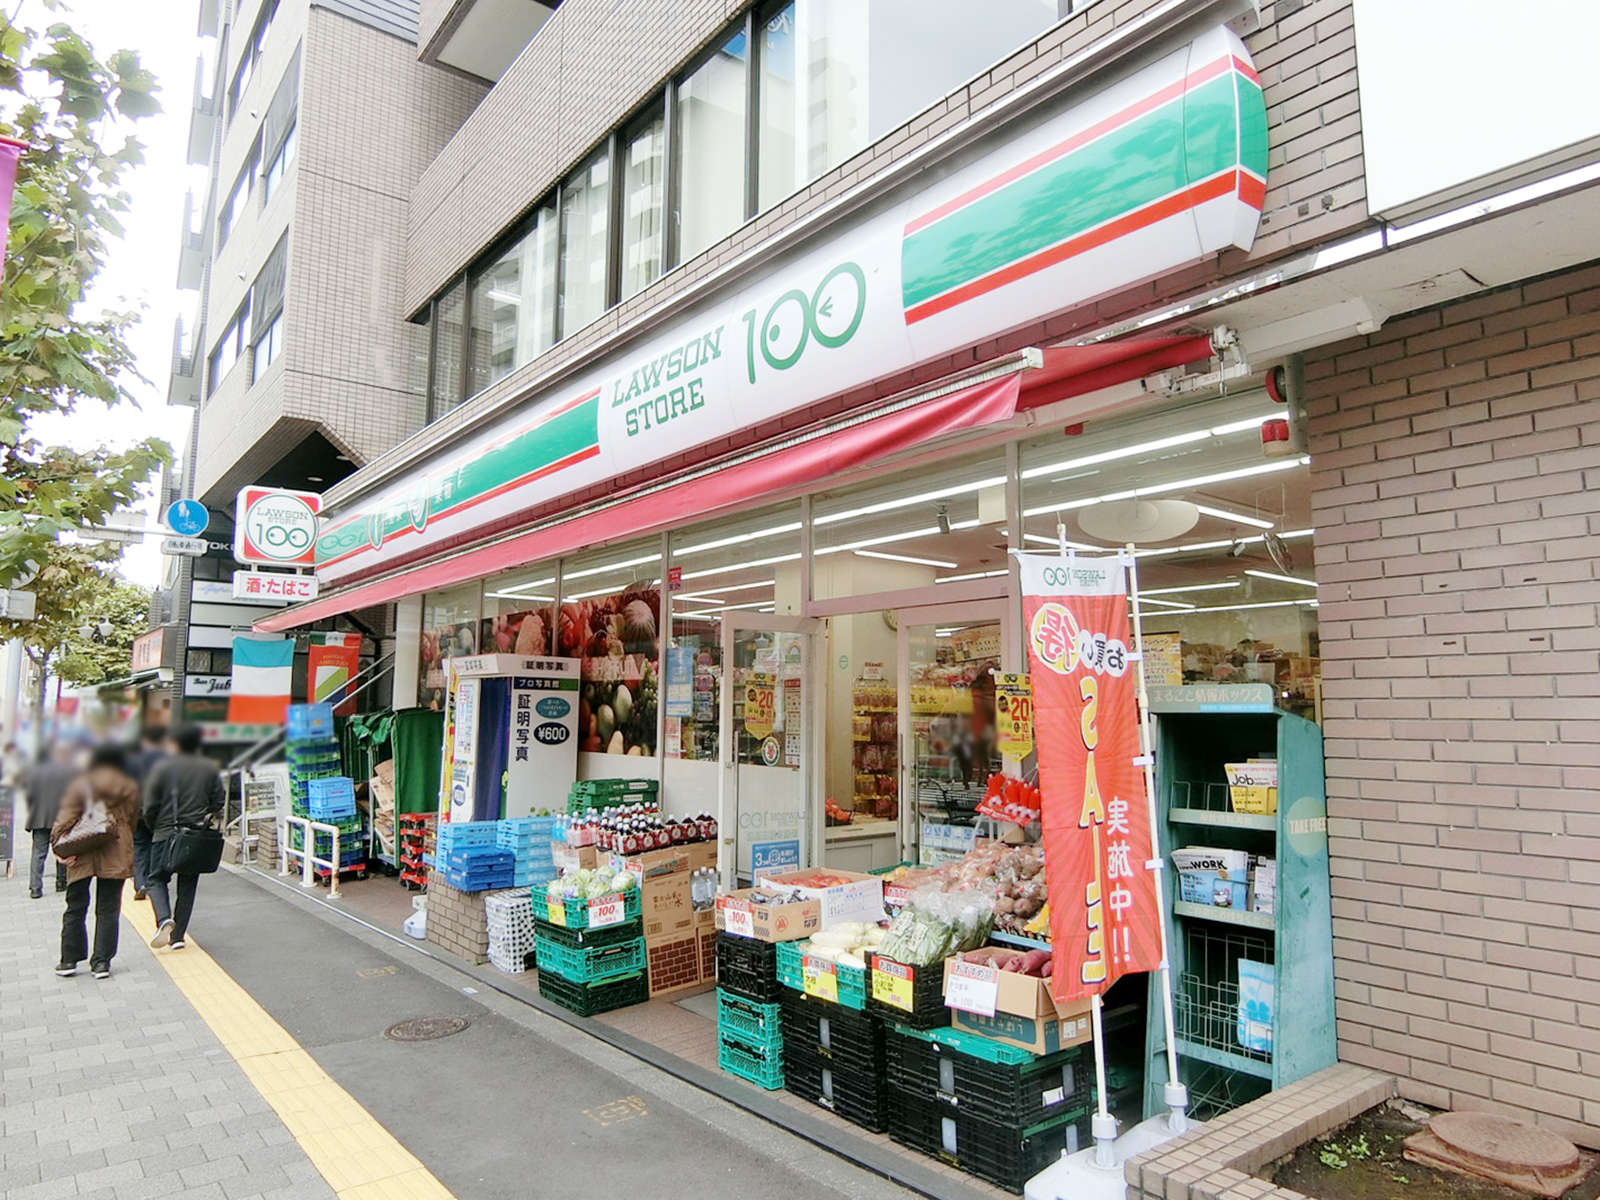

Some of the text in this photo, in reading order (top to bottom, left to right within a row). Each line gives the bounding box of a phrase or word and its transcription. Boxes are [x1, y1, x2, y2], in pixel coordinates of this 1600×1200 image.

[611, 261, 867, 408] LAWSON 100
[625, 377, 705, 437] STORE
[257, 507, 309, 521] LAWSON
[267, 517, 298, 526] STORE
[256, 523, 309, 548] 100
[246, 577, 310, 597] 酒・たばこ
[525, 660, 564, 671] 証明写真
[519, 679, 560, 689] プロ写真館
[515, 693, 532, 762] 証明写真
[537, 727, 567, 741] ¥600
[1232, 773, 1254, 786] Job
[1289, 816, 1327, 835] TAKE FREE
[1190, 859, 1228, 870] WORK
[598, 904, 616, 917] 100
[731, 911, 746, 925] 100
[879, 959, 907, 979] お買得品
[955, 964, 992, 980] おすすめ品
[960, 997, 973, 1008] 100
